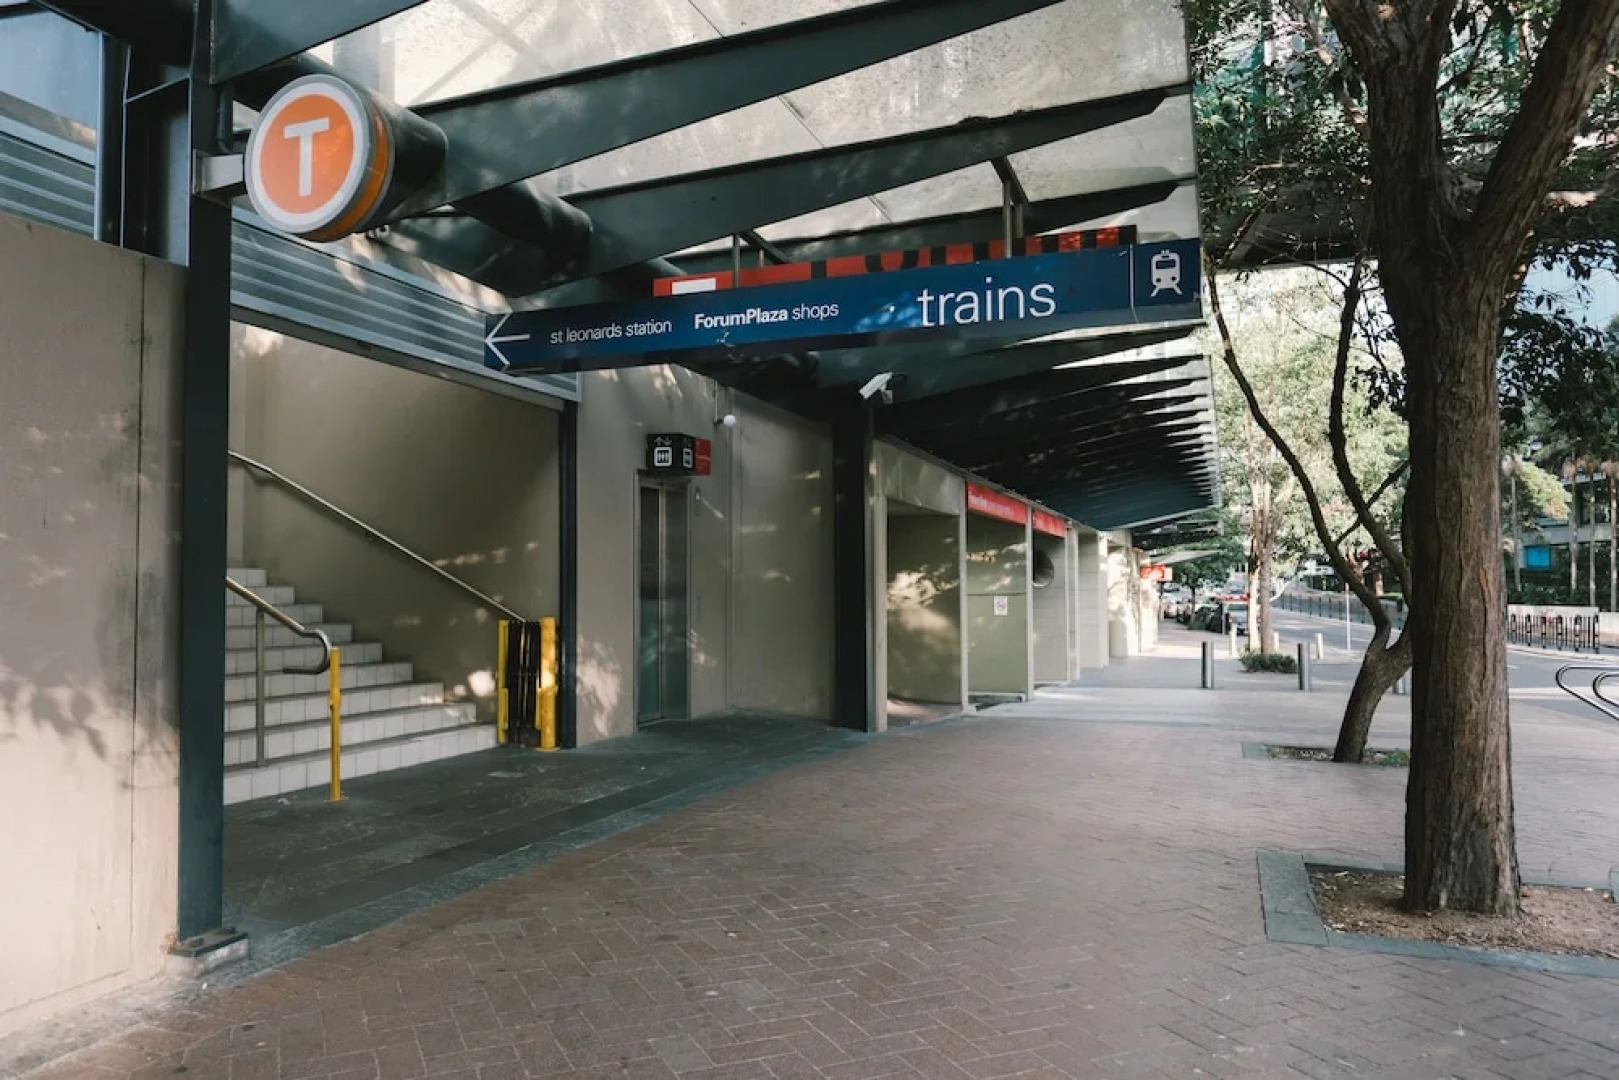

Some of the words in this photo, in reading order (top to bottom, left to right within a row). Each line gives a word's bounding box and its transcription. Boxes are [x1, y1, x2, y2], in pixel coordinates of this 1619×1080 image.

[284, 117, 330, 197] T
[694, 308, 788, 329] ForumPlaza
[792, 303, 840, 321] shops
[917, 276, 1056, 327] trains
[550, 330, 563, 344] st
[566, 323, 622, 343] leonards
[625, 318, 672, 337] station
